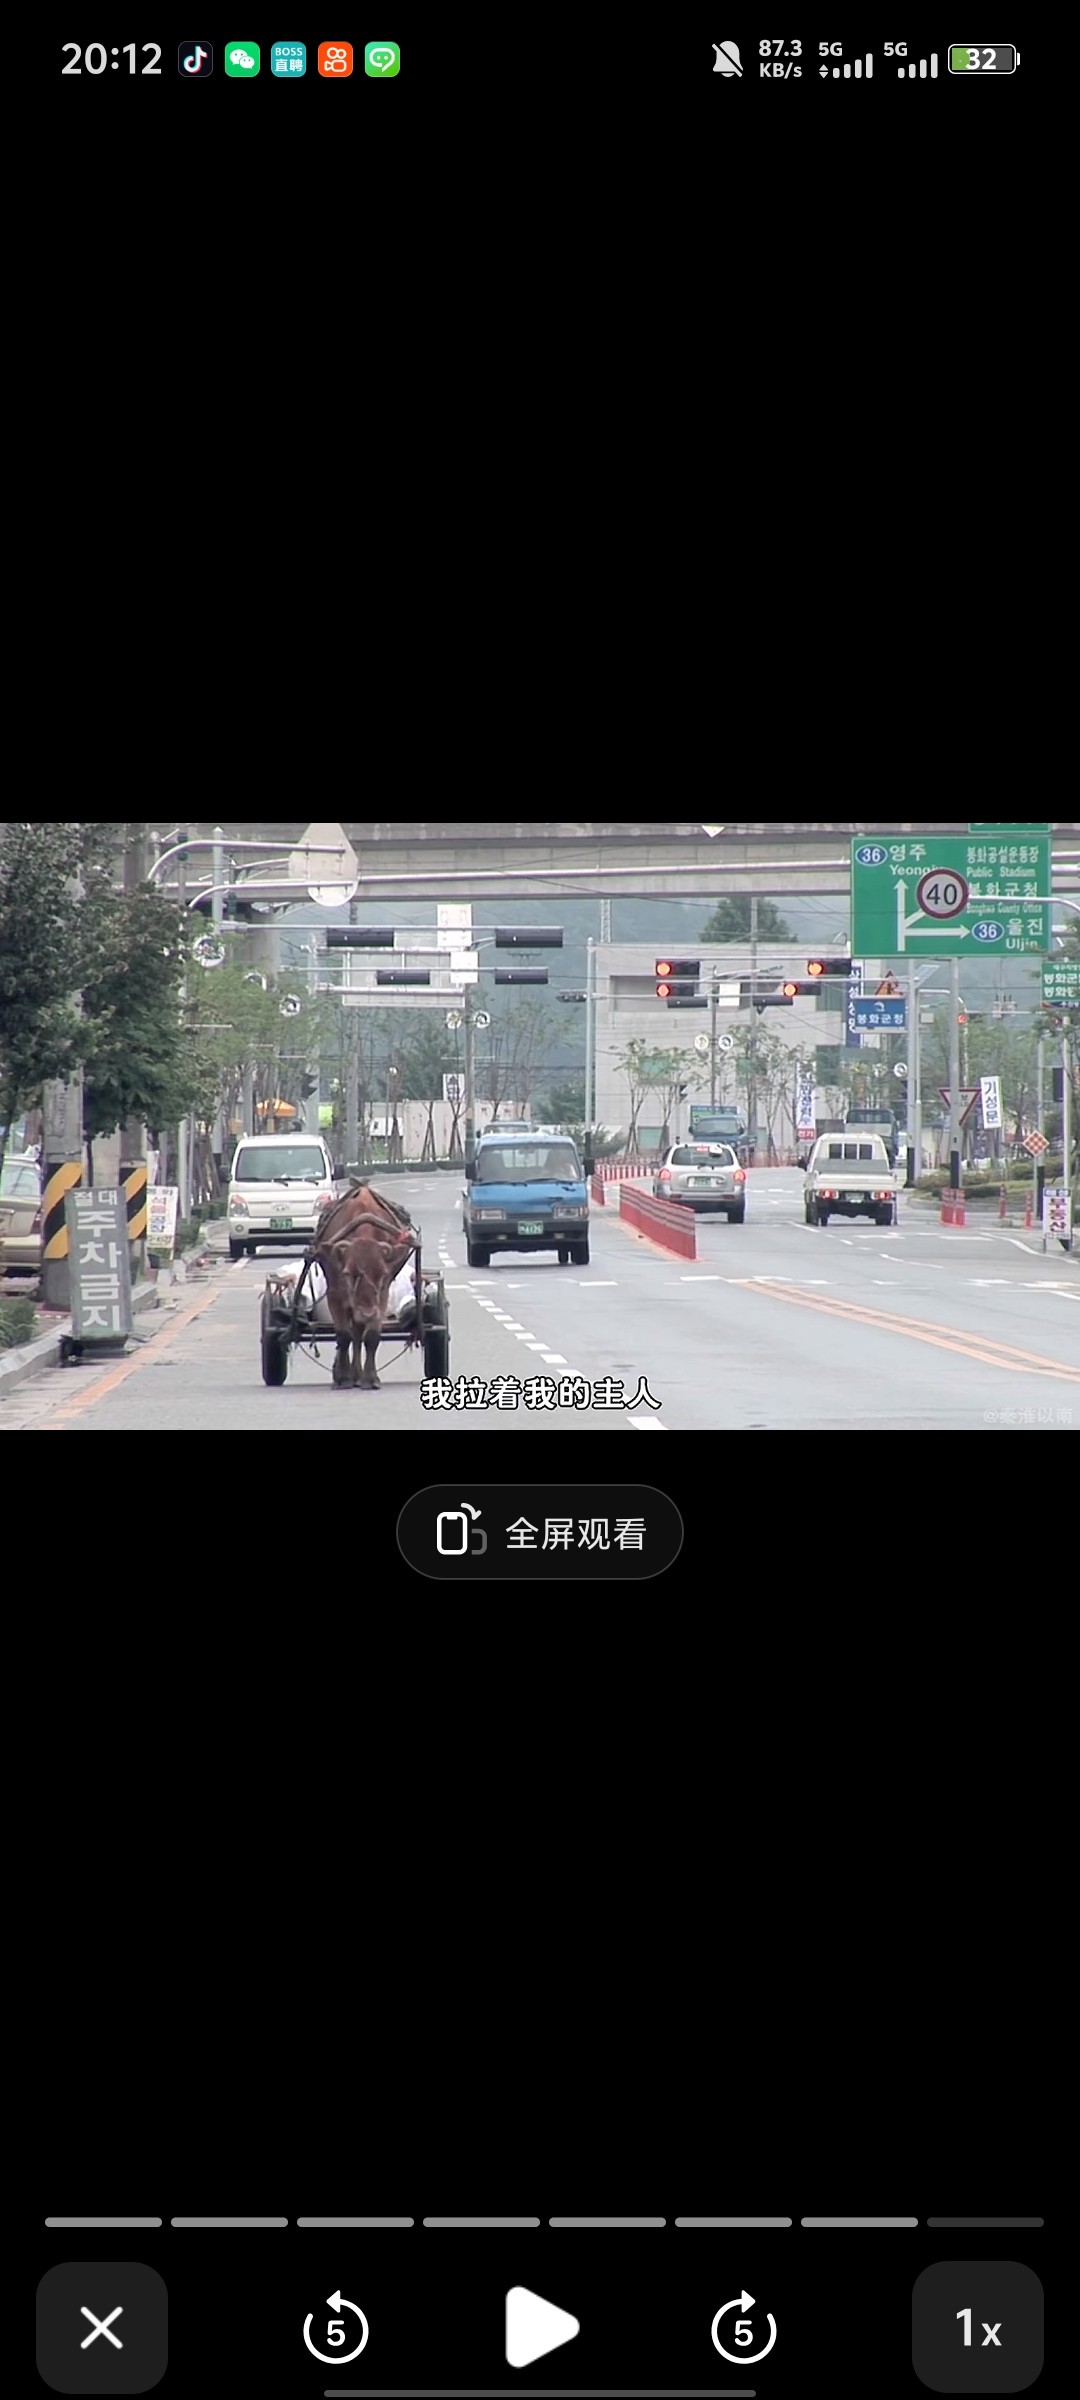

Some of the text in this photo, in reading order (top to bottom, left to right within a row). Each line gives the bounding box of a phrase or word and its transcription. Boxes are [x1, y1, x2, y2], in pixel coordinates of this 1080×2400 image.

[275, 47, 303, 57] BOSS
[758, 39, 803, 57] 87.3
[818, 41, 843, 57] 5G
[883, 41, 908, 57] 5G
[61, 42, 162, 75] 20:12
[274, 58, 303, 72] 直聘
[965, 48, 997, 70] 32
[759, 62, 803, 79] KB/s
[862, 847, 882, 863] 36
[889, 843, 927, 862] 영주
[967, 845, 1039, 864] 봉화공설운동장
[966, 866, 1037, 878] Public Stadium
[926, 883, 958, 906] 40
[978, 923, 997, 939] 36
[1006, 917, 1044, 936] 울진
[1005, 938, 1039, 951] Uljin
[73, 1190, 118, 1207] 절대
[1048, 1197, 1068, 1233] 부동산
[77, 1210, 123, 1332] 주차금지
[505, 1516, 647, 1551] 全屏观看
[326, 2319, 346, 2347] 5
[734, 2319, 754, 2347] 5
[956, 2308, 1002, 2347] 1x
